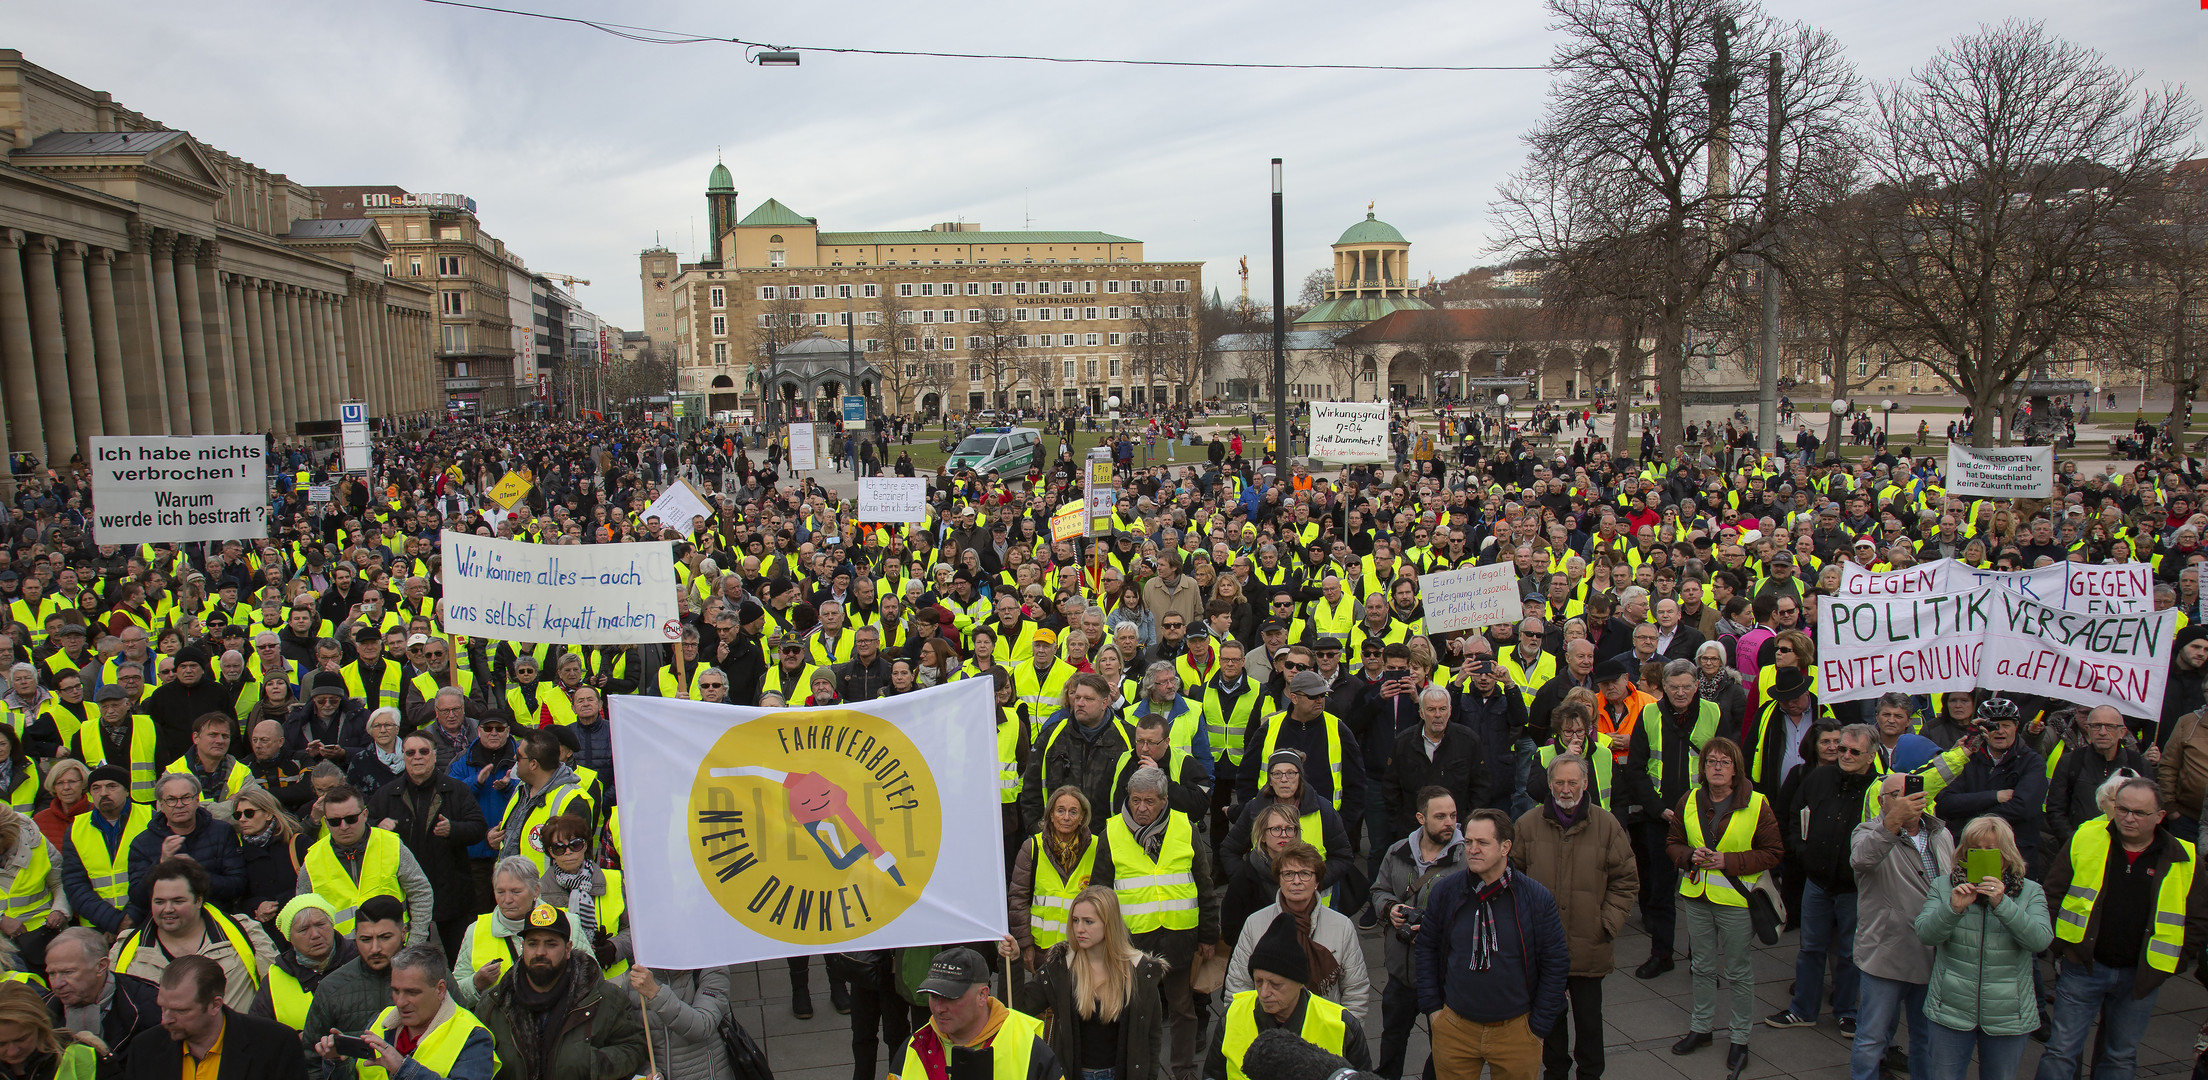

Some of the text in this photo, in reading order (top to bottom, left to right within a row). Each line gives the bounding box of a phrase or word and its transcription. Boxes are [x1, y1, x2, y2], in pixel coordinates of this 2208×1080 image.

[361, 193, 391, 207] EM
[345, 406, 359, 419] U
[1315, 406, 1386, 422] Wirkungsgrad
[1317, 435, 1333, 443] statt
[1335, 435, 1375, 445] Dummheit
[98, 445, 261, 461] Ich habe nichts
[1015, 457, 1028, 466] POLIZEI
[1098, 464, 1109, 473] Pro
[2007, 464, 2023, 472] und
[111, 467, 234, 481] verbrochen
[1980, 472, 2032, 481] Deutschland
[866, 480, 876, 490] Ich
[1981, 482, 2012, 490] Zukunft
[155, 491, 214, 508] Warum
[860, 503, 878, 512] Wann
[881, 502, 891, 512] bin
[891, 502, 901, 512] ich
[99, 511, 153, 528] werde
[157, 510, 183, 526] ich
[188, 508, 251, 526] bestraft
[1062, 514, 1077, 522] Pro
[455, 543, 482, 577] Wir
[486, 550, 531, 583] können
[537, 557, 576, 586] alles
[600, 560, 642, 586] auch
[1432, 567, 1506, 587] Euro 4 ist legal!
[1849, 569, 1936, 595] GEGEN
[2069, 569, 2147, 597] GEGEN
[1427, 588, 1472, 605] Enteignung
[1473, 588, 1481, 597] ist
[1431, 596, 1498, 618] der Politik ist's
[450, 601, 655, 638] uns selbst kaputt machen
[1443, 608, 1505, 629] scheißegal!
[1831, 588, 1991, 645] POLITIK
[2002, 592, 2162, 657] VERSAGEN
[1824, 642, 1984, 692] ENTEIGNUNG
[777, 725, 919, 811] FAHRVERBOTE?
[698, 810, 872, 932] NEIN DANKE!
